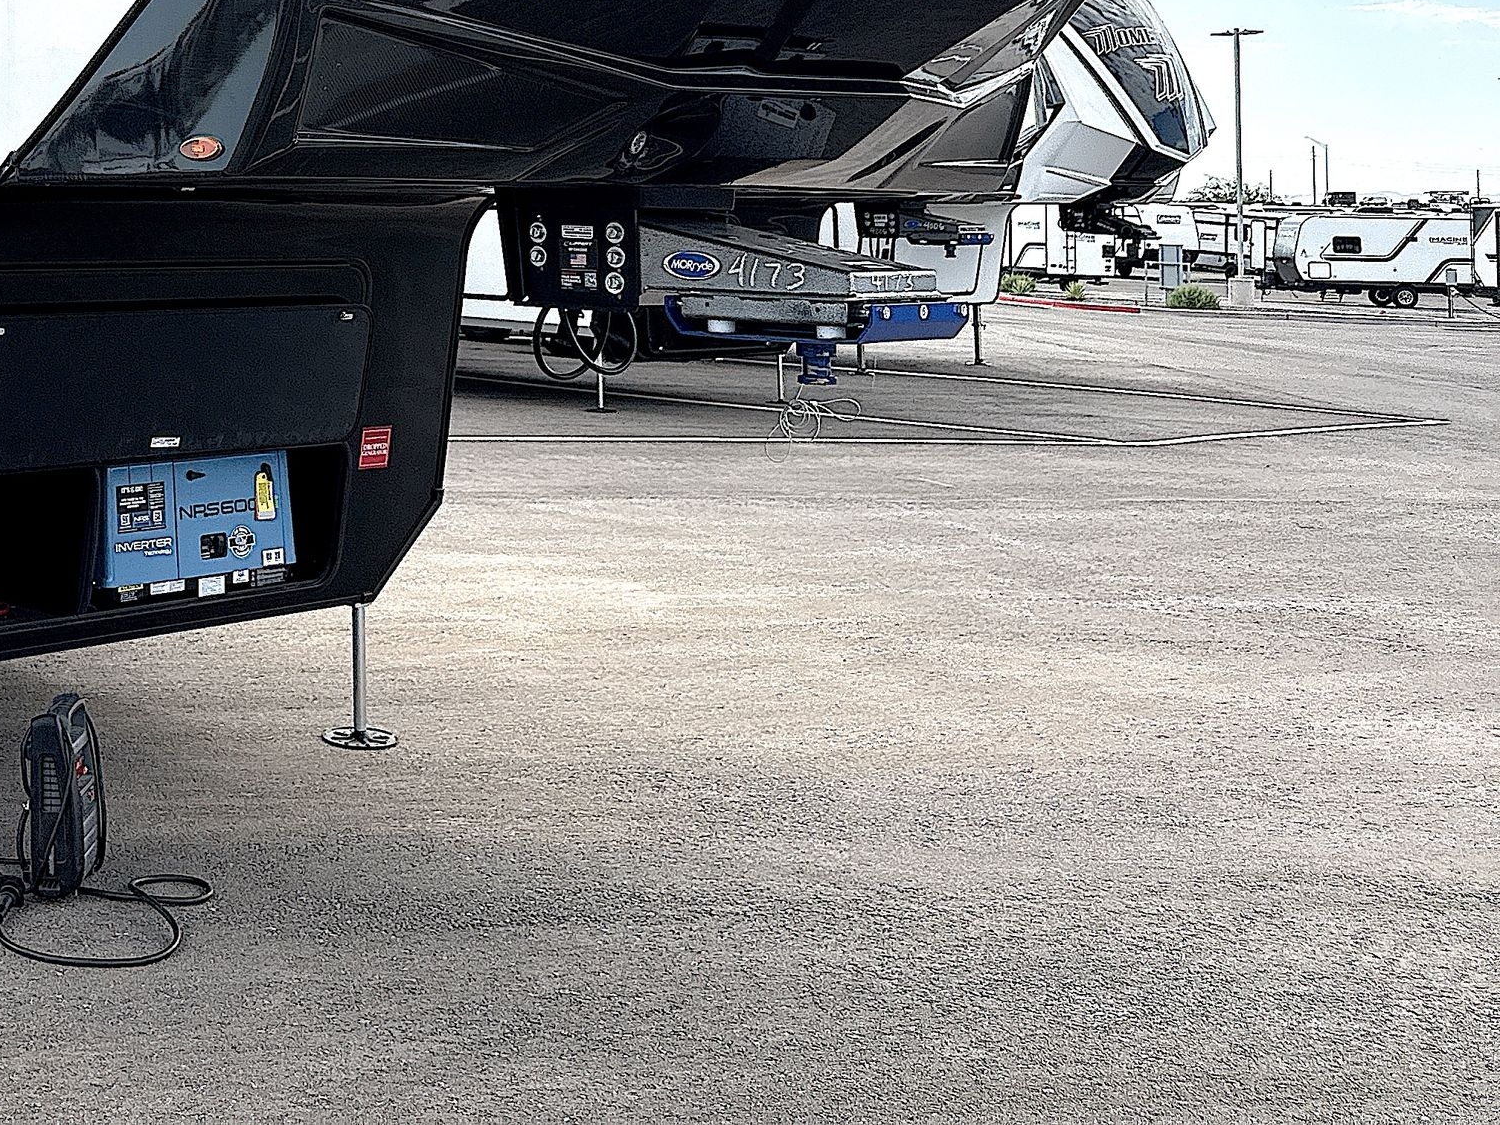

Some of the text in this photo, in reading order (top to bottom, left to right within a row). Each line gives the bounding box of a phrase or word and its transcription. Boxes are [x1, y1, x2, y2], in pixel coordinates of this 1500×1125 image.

[728, 252, 806, 290] 4173
[871, 274, 915, 290] 4173
[115, 537, 172, 553] INVERTER
